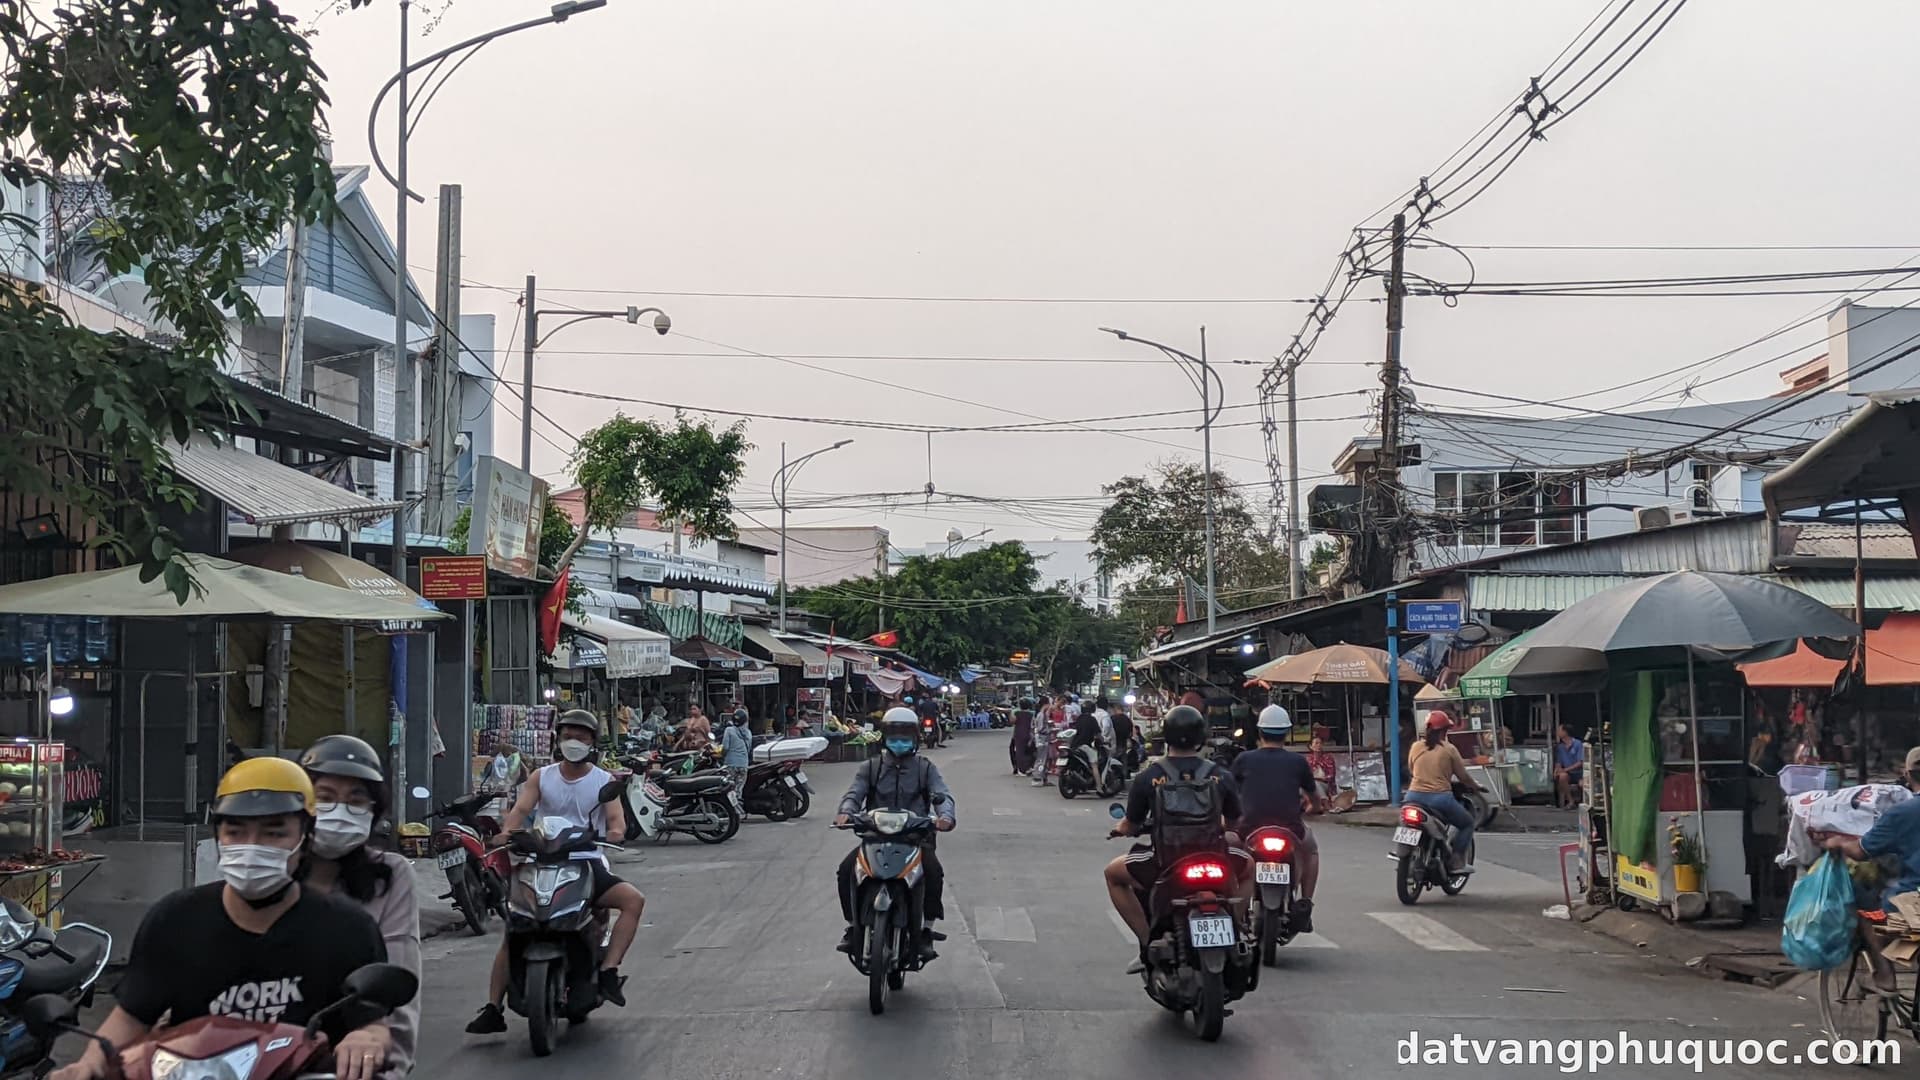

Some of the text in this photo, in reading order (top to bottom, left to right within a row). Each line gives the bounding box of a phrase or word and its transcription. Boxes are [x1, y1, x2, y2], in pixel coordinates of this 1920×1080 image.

[1197, 920, 1227, 932] 68-P1
[1193, 932, 1234, 946] 782.11
[208, 975, 305, 1016] WORK
